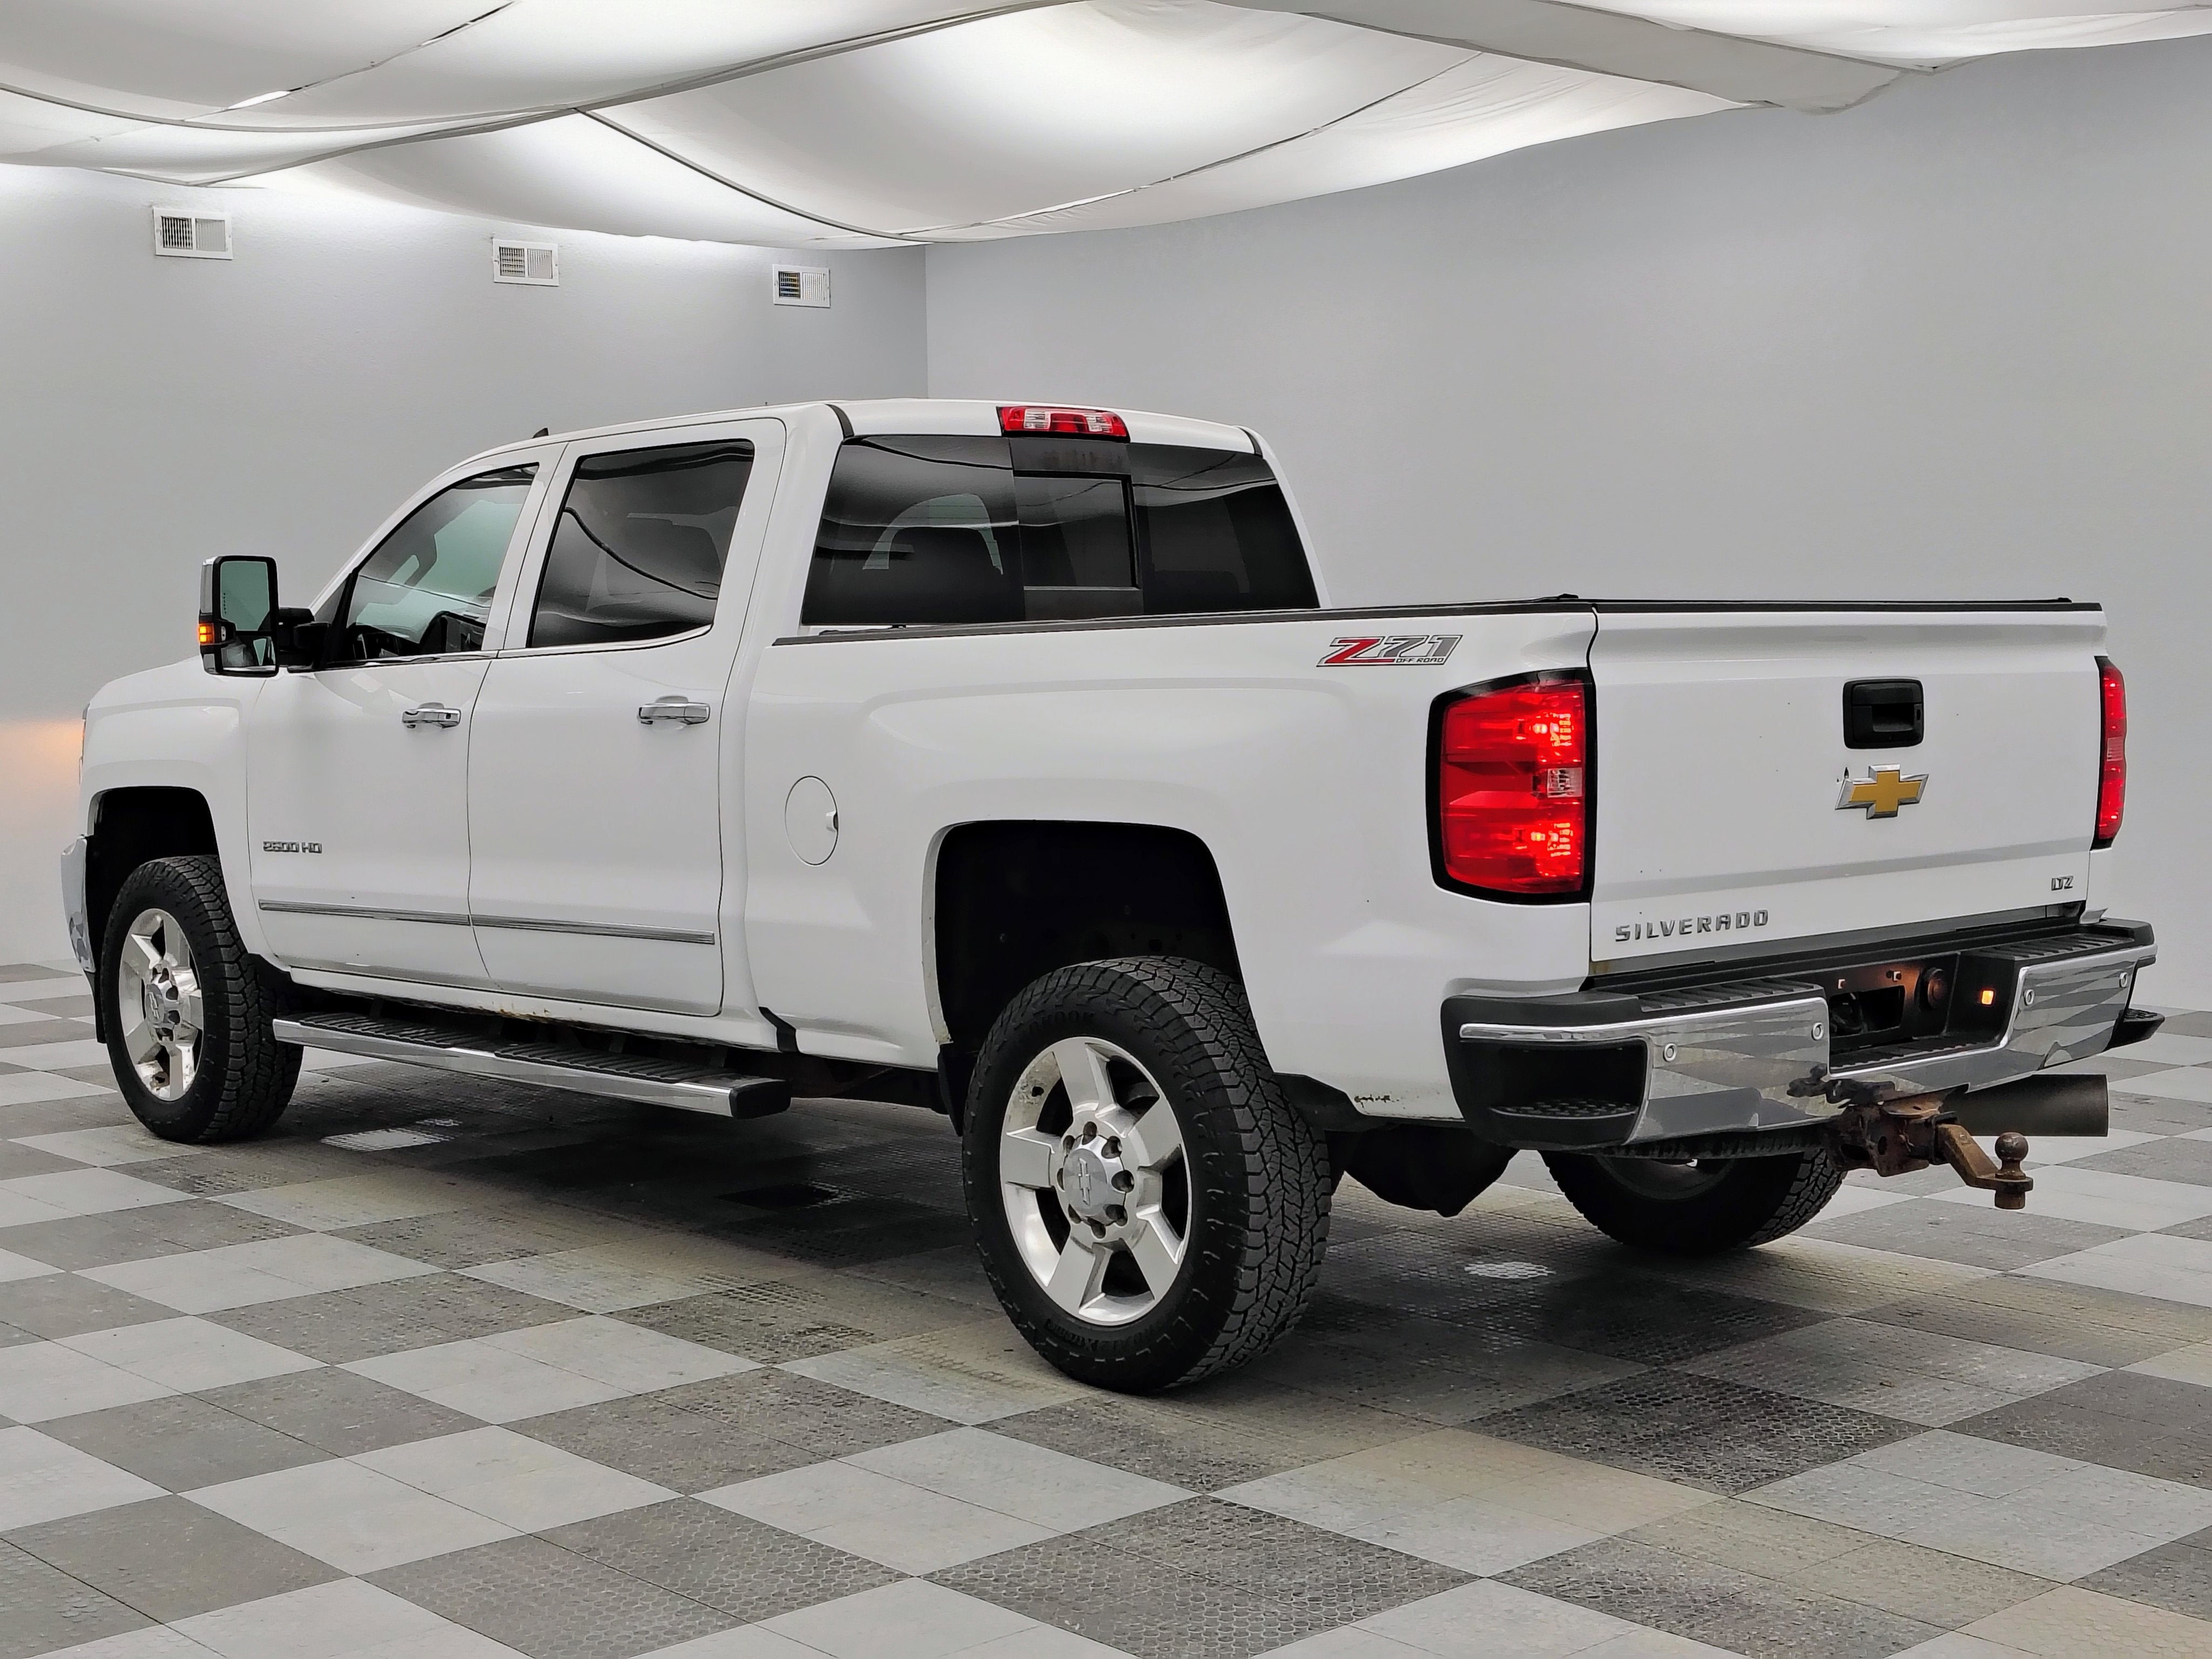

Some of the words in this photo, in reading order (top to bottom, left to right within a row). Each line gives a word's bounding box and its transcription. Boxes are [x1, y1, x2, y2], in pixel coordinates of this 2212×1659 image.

[1316, 634, 1464, 667] Z71
[263, 841, 299, 853] 2500
[301, 842, 322, 854] HD
[2051, 875, 2074, 891] LTZ
[1615, 909, 1769, 942] SILVERADO
